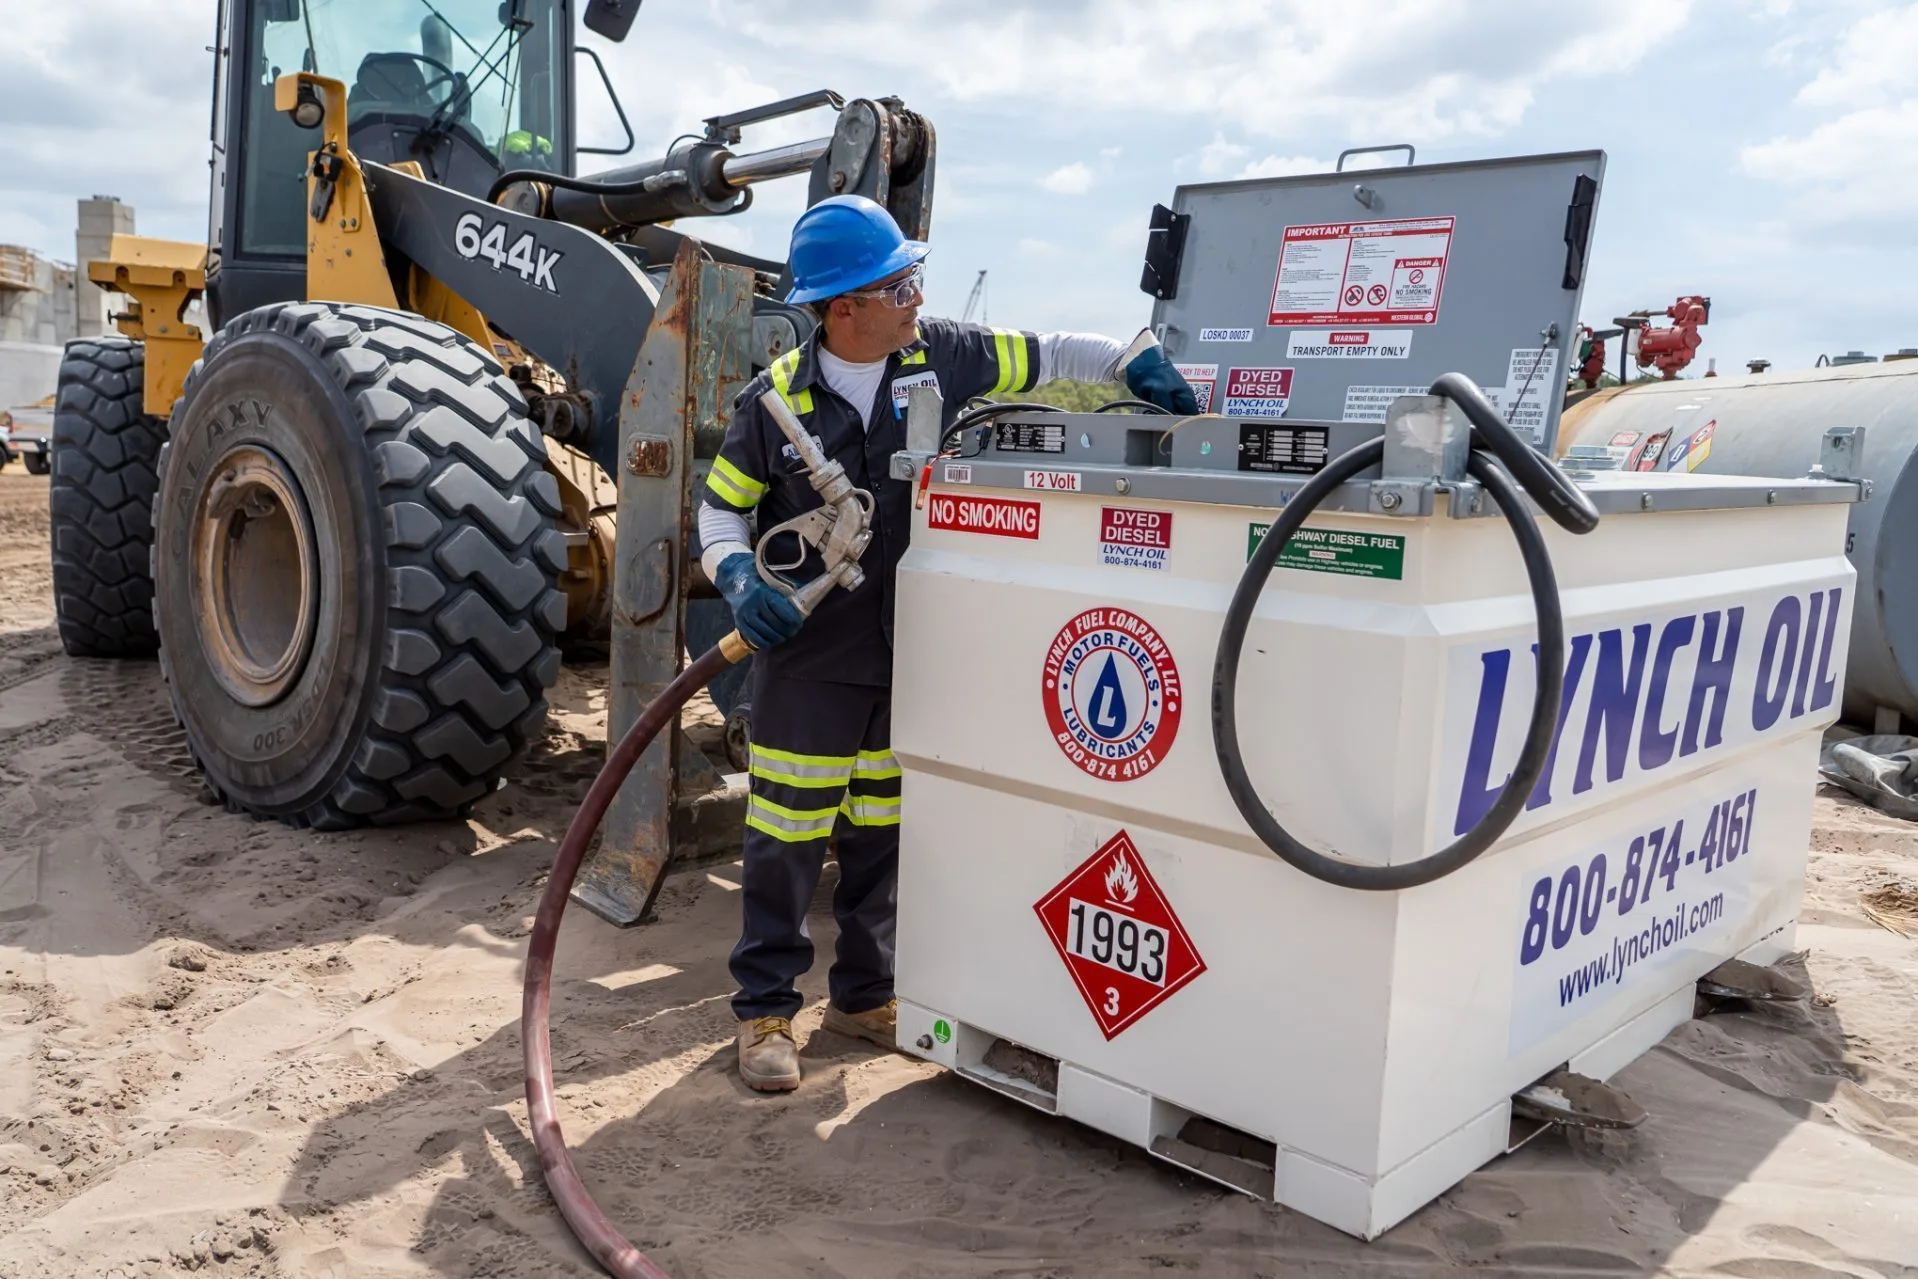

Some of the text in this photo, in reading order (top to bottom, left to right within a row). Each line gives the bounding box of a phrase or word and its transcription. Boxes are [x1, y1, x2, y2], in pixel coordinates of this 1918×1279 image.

[1287, 226, 1346, 237] IMPORTANT
[455, 212, 562, 294] 644K
[1333, 334, 1365, 342] WARNING
[1292, 346, 1407, 356] TRANSPORT EMPTY ONLY
[1240, 371, 1282, 382] DYED
[1231, 384, 1286, 396] DIESEL
[1227, 399, 1284, 408] LYNCH OIL
[1228, 408, 1280, 417] 800-874-4161
[1029, 472, 1076, 490] 12 Volt
[931, 499, 1037, 533] NO SMOKING
[1113, 511, 1160, 528] DYED
[1105, 526, 1166, 545] DIESEL
[1329, 533, 1368, 547] DIESEL
[1370, 537, 1400, 550] FUEL
[1846, 532, 1856, 554] 5
[1103, 544, 1167, 560] LYNCH OIL
[1104, 555, 1162, 570] 800-874-4161
[1046, 627, 1074, 677] LYNCH
[1074, 610, 1105, 634] FUEL
[1161, 668, 1179, 698] LLC
[1062, 632, 1160, 692] MOTOR FUELS
[1096, 685, 1117, 728] L
[1454, 587, 1843, 837] LYNCH OIL
[253, 726, 287, 751] 300
[1063, 707, 1155, 758] LUBRICANTS
[1122, 749, 1156, 779] 4161
[1519, 788, 1758, 966] 800-874-4161
[1070, 903, 1165, 984] 1993
[1559, 891, 1724, 1007] www.lynchoil.com
[1103, 986, 1120, 1017] 3
